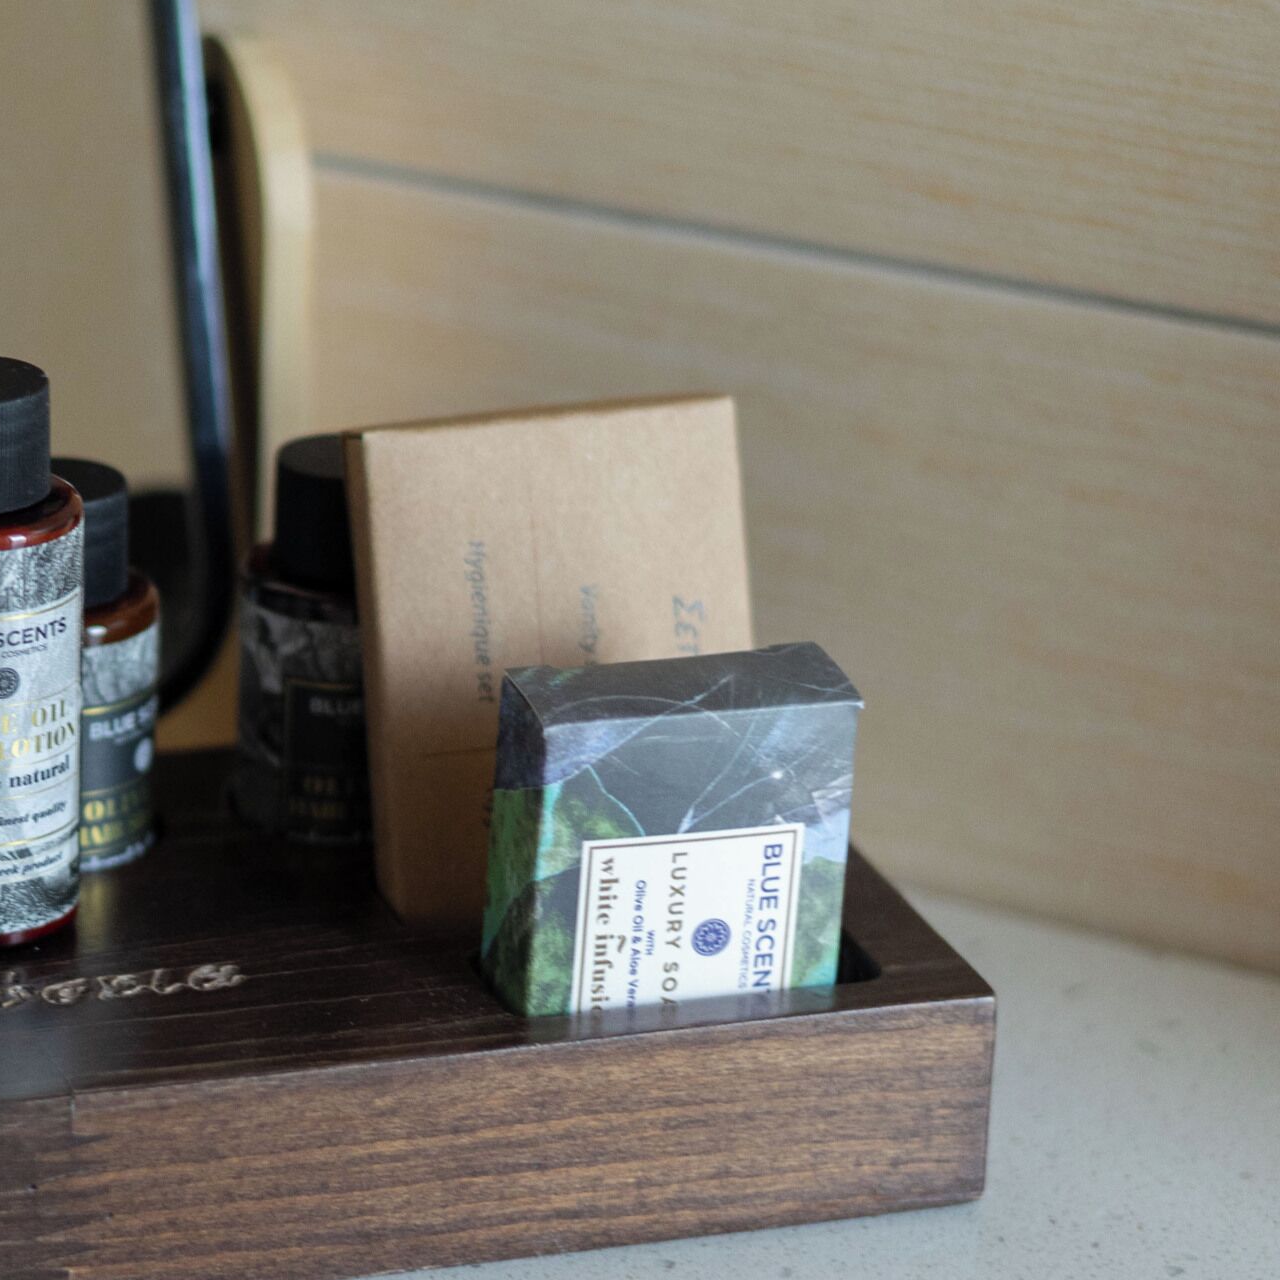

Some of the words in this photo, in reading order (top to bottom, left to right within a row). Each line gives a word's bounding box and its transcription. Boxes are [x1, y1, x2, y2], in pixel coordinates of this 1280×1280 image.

[31, 698, 66, 728] OIL
[8, 753, 70, 789] natural
[596, 856, 620, 926] white
[757, 842, 784, 912] BLUE
[633, 879, 648, 912] Olive
[664, 851, 689, 949] LUXURY
[744, 877, 756, 927] NATURAL
[631, 934, 644, 945] &
[632, 914, 645, 933] Oil
[645, 929, 656, 956] WITH
[737, 929, 753, 990] COSMETICS
[751, 918, 779, 992] SCEN
[628, 947, 642, 977] Aloe
